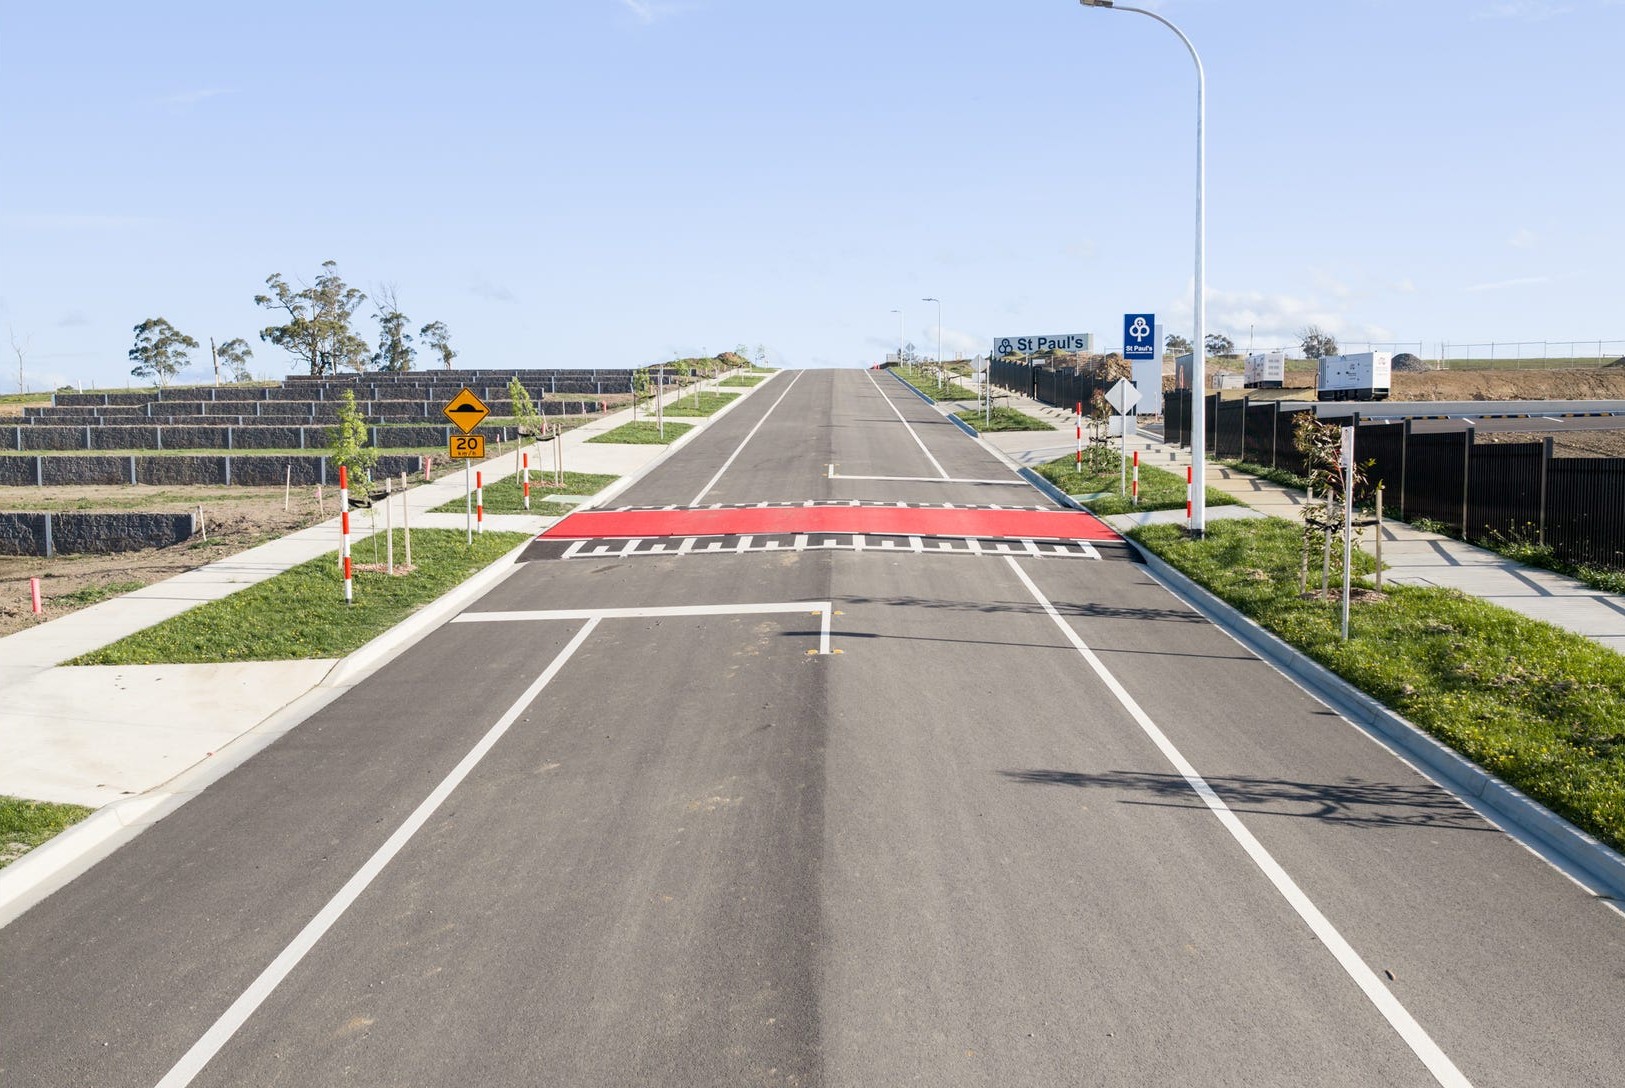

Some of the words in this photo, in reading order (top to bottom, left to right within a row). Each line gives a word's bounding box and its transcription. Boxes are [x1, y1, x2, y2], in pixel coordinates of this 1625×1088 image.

[1017, 338, 1032, 351] St
[1038, 336, 1083, 350] Paul's
[456, 438, 477, 449] 20
